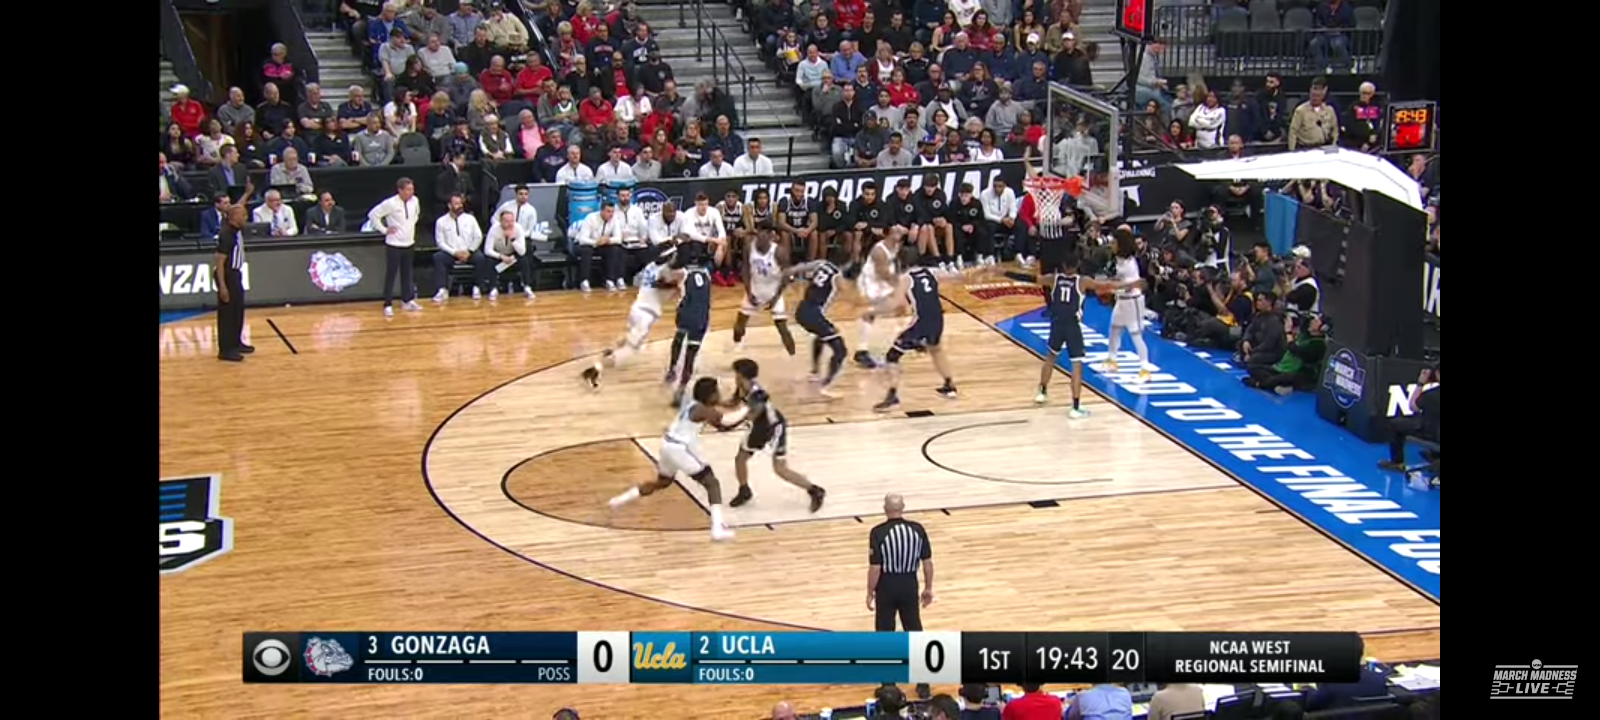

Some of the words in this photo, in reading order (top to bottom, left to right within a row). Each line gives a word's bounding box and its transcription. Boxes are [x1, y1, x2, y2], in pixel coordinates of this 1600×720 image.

[694, 272, 704, 288] 0
[920, 278, 932, 293] 2
[1060, 285, 1071, 302] 11
[1149, 397, 1243, 421] TO
[1193, 423, 1316, 461] THE
[1255, 465, 1420, 525] FINAL
[1361, 529, 1441, 575] FO
